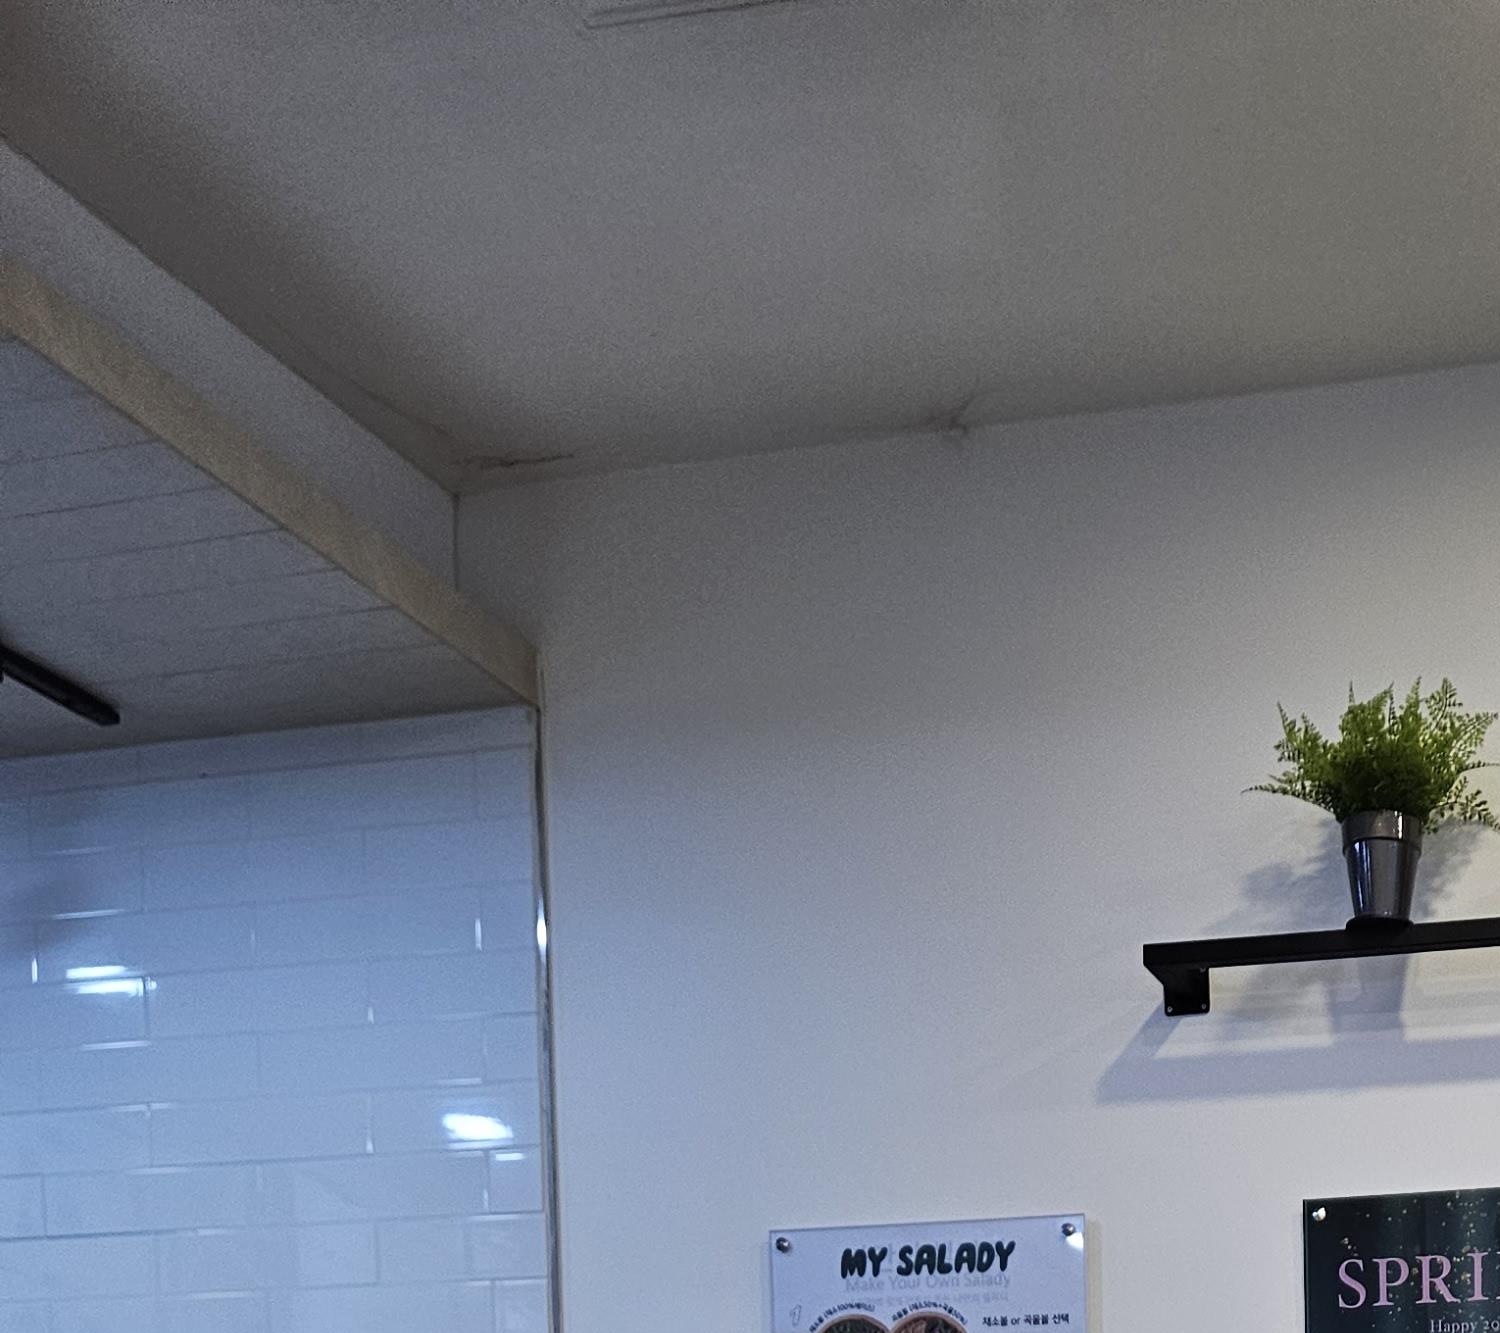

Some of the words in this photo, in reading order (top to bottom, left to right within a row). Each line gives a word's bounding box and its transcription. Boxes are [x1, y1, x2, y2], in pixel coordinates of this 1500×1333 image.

[841, 1246, 888, 1279] MY
[897, 1241, 1016, 1276] SALADY
[982, 1316, 1008, 1327] 채소볼
[1052, 1313, 1069, 1324] 선택
